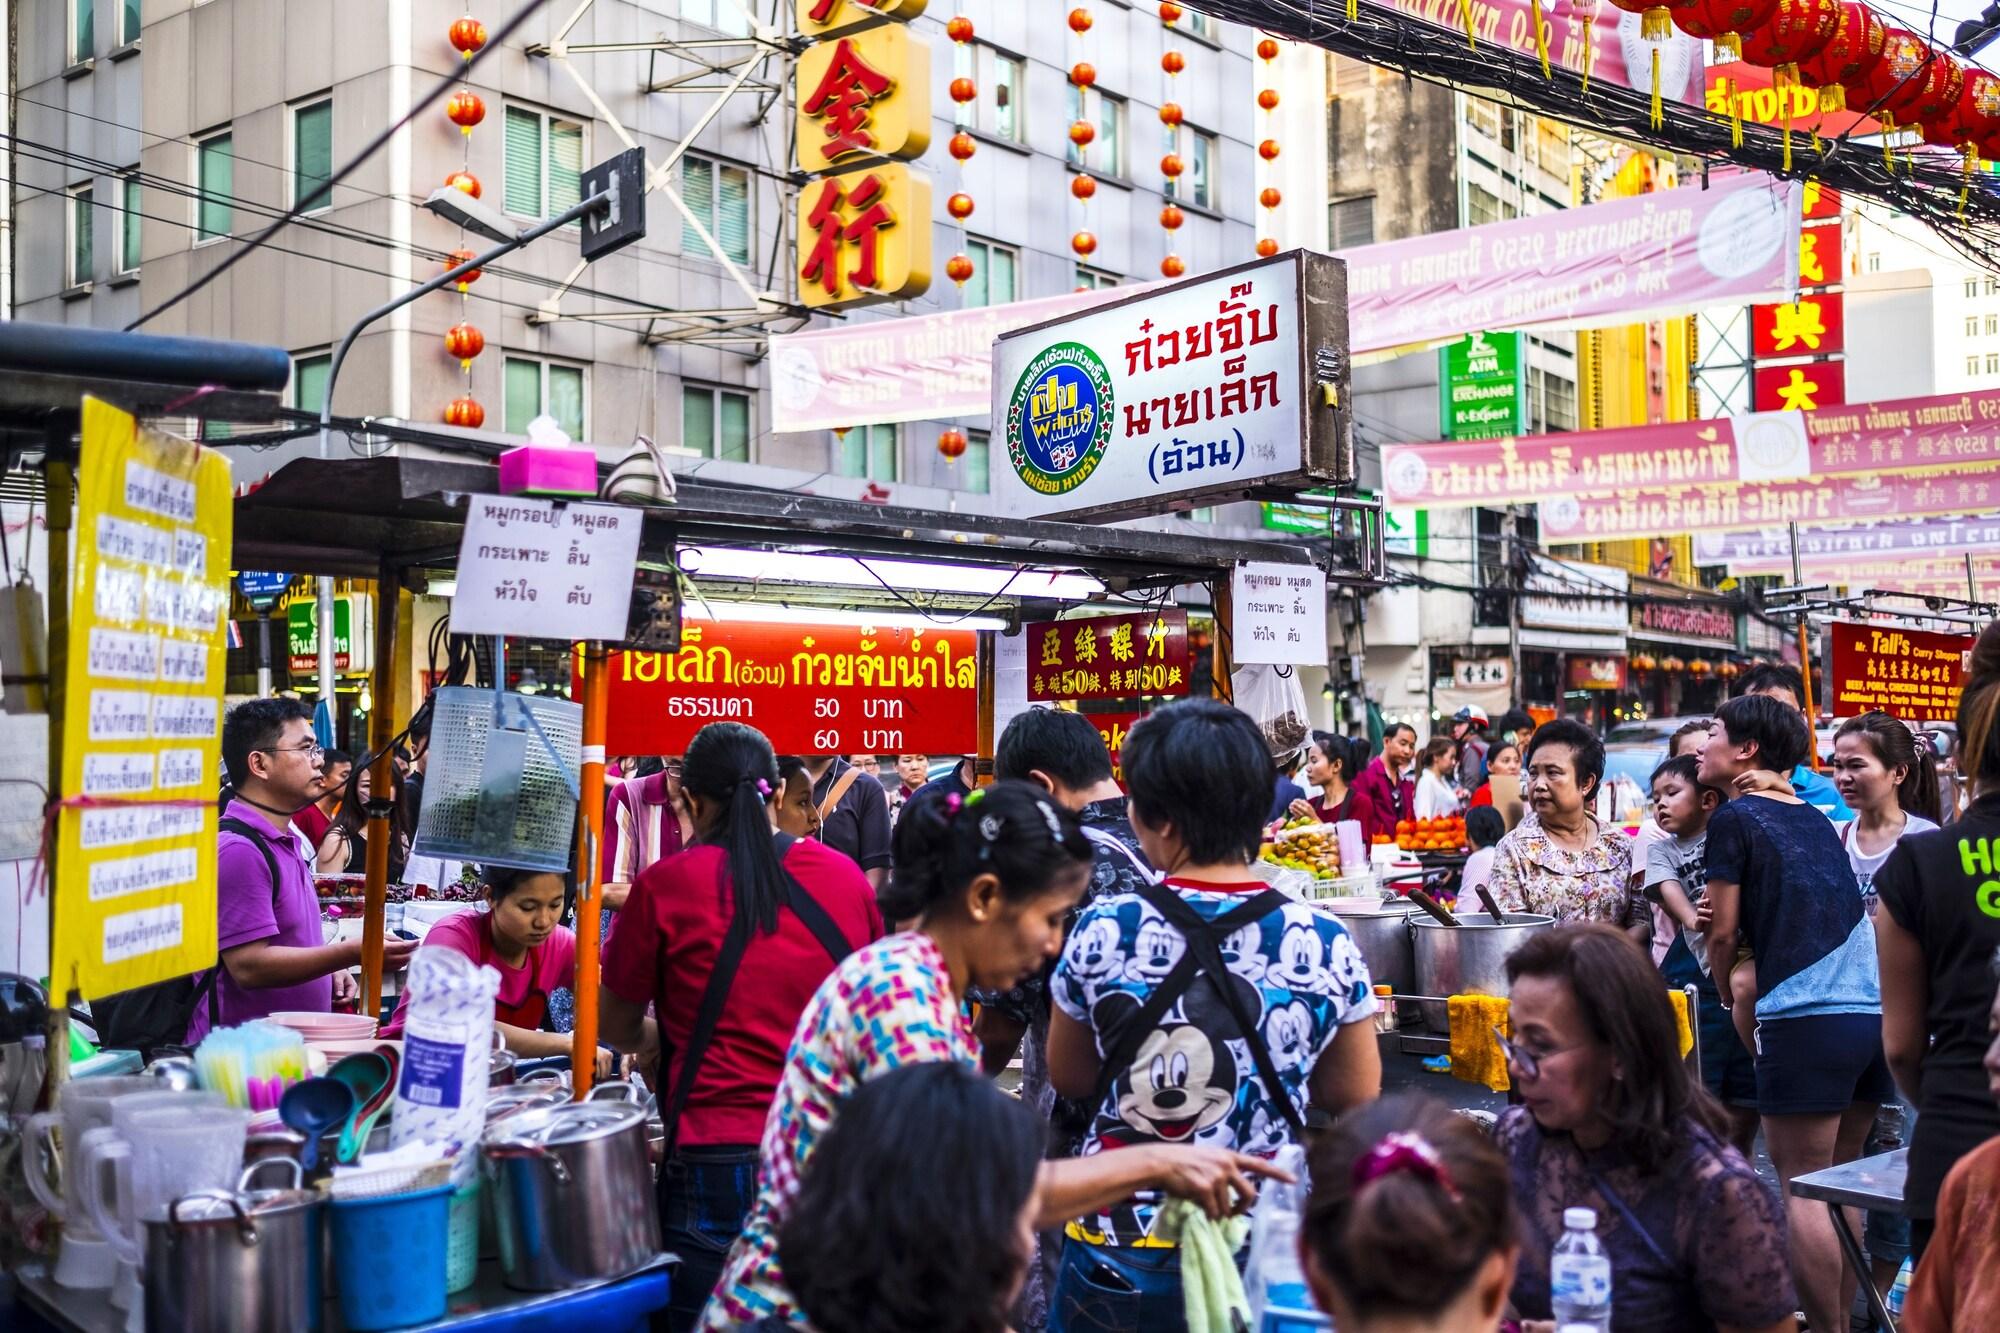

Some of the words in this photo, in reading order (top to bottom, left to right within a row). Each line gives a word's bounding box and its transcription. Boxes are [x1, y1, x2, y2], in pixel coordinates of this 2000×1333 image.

[800, 0, 897, 299] 金行
[1125, 281, 1279, 377] ก๋วยจั๊บ
[1468, 357, 1499, 373] ATM
[1123, 354, 1281, 438] นายเล็ก
[1453, 384, 1514, 402] EXCHANGE
[1456, 406, 1510, 424] K-Expert
[1148, 428, 1245, 484] (อ้วน)
[484, 505, 555, 527] หมูกรอบ
[572, 512, 619, 535] หมูสด
[478, 544, 550, 563] กระเพาะ
[567, 539, 591, 566] ลิ้น
[495, 579, 537, 601] หัวใจ
[566, 585, 592, 605] ตับ
[1243, 574, 1281, 590] หมูกรอบ
[1287, 577, 1312, 592] หมูสด
[1247, 602, 1285, 614] กระเพาะ
[1293, 597, 1306, 615] ลิ้น
[1253, 625, 1276, 641] หัวใจ
[1287, 627, 1301, 642] ตับ
[1855, 641, 1868, 652] Mr.
[1872, 631, 1910, 656] Tall's
[1913, 647, 1934, 660] Curry
[668, 696, 753, 718] ธรรมดา
[814, 698, 839, 718] 50
[863, 698, 903, 718] บาท
[814, 730, 839, 749] 60
[863, 729, 903, 749] บาท
